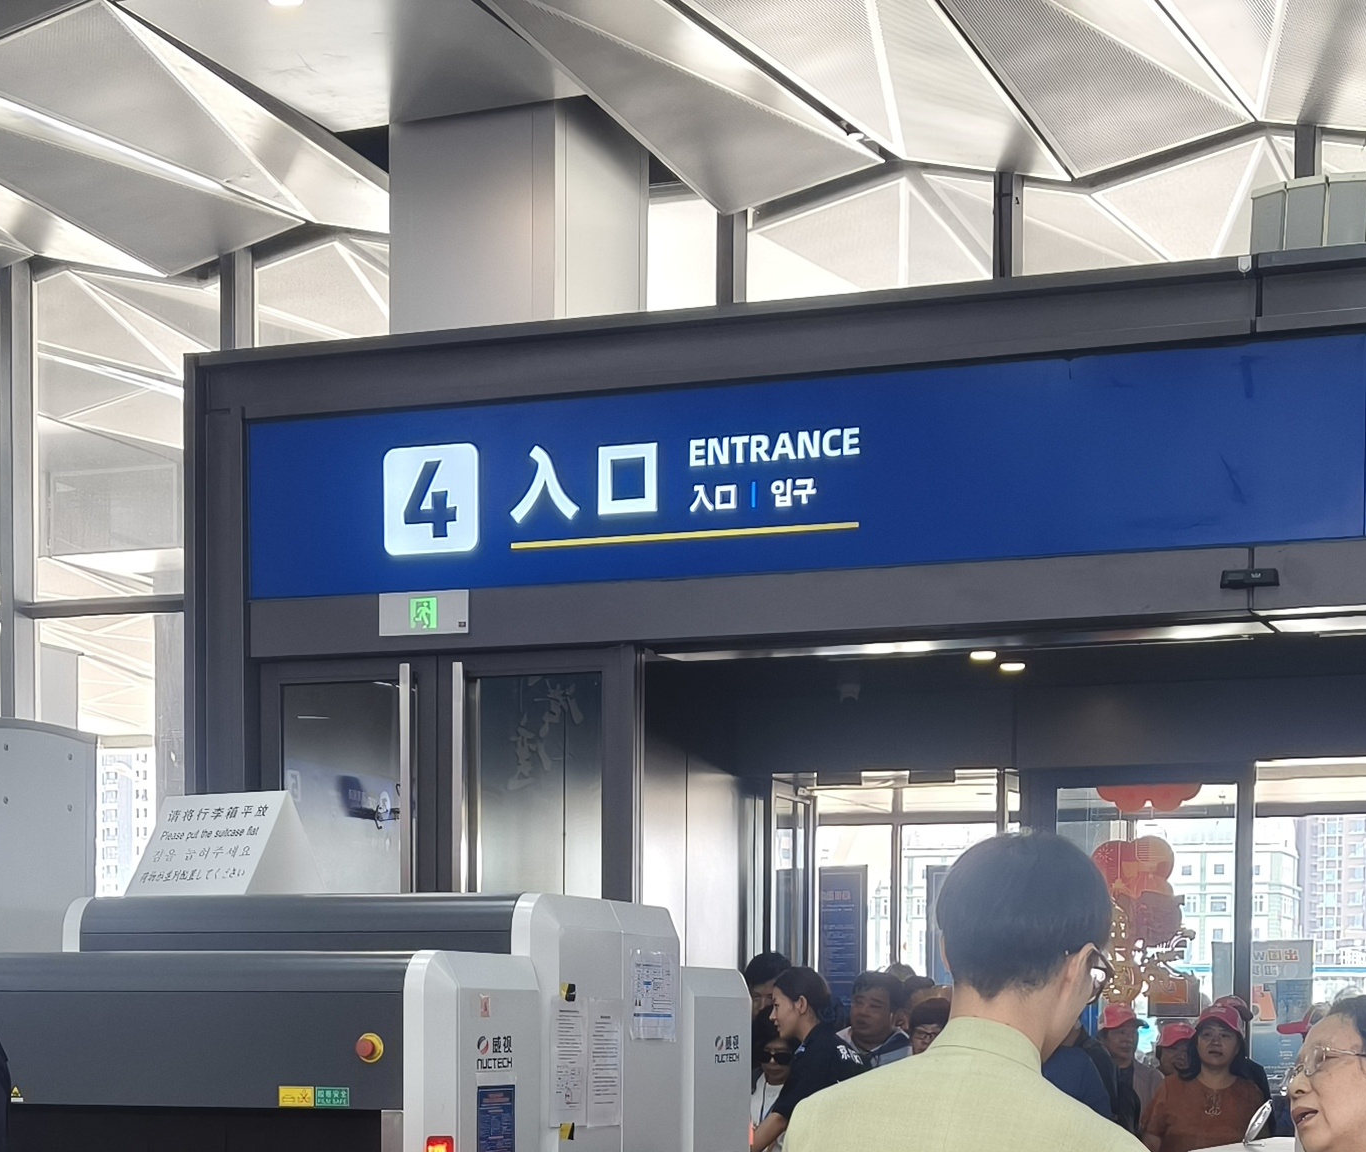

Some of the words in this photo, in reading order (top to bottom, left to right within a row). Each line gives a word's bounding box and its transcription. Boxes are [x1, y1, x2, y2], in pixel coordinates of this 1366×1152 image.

[688, 426, 861, 468] ENTRANCE
[509, 442, 659, 524] 入口
[690, 483, 738, 513] 入口
[770, 477, 818, 508] 입구
[403, 459, 458, 538] 4
[167, 804, 269, 823] 请将行李箱平放
[160, 830, 184, 841] Please
[185, 829, 199, 841] put
[200, 827, 212, 839] the
[213, 826, 245, 838] suitcase
[476, 1057, 513, 1070] NUCTECH
